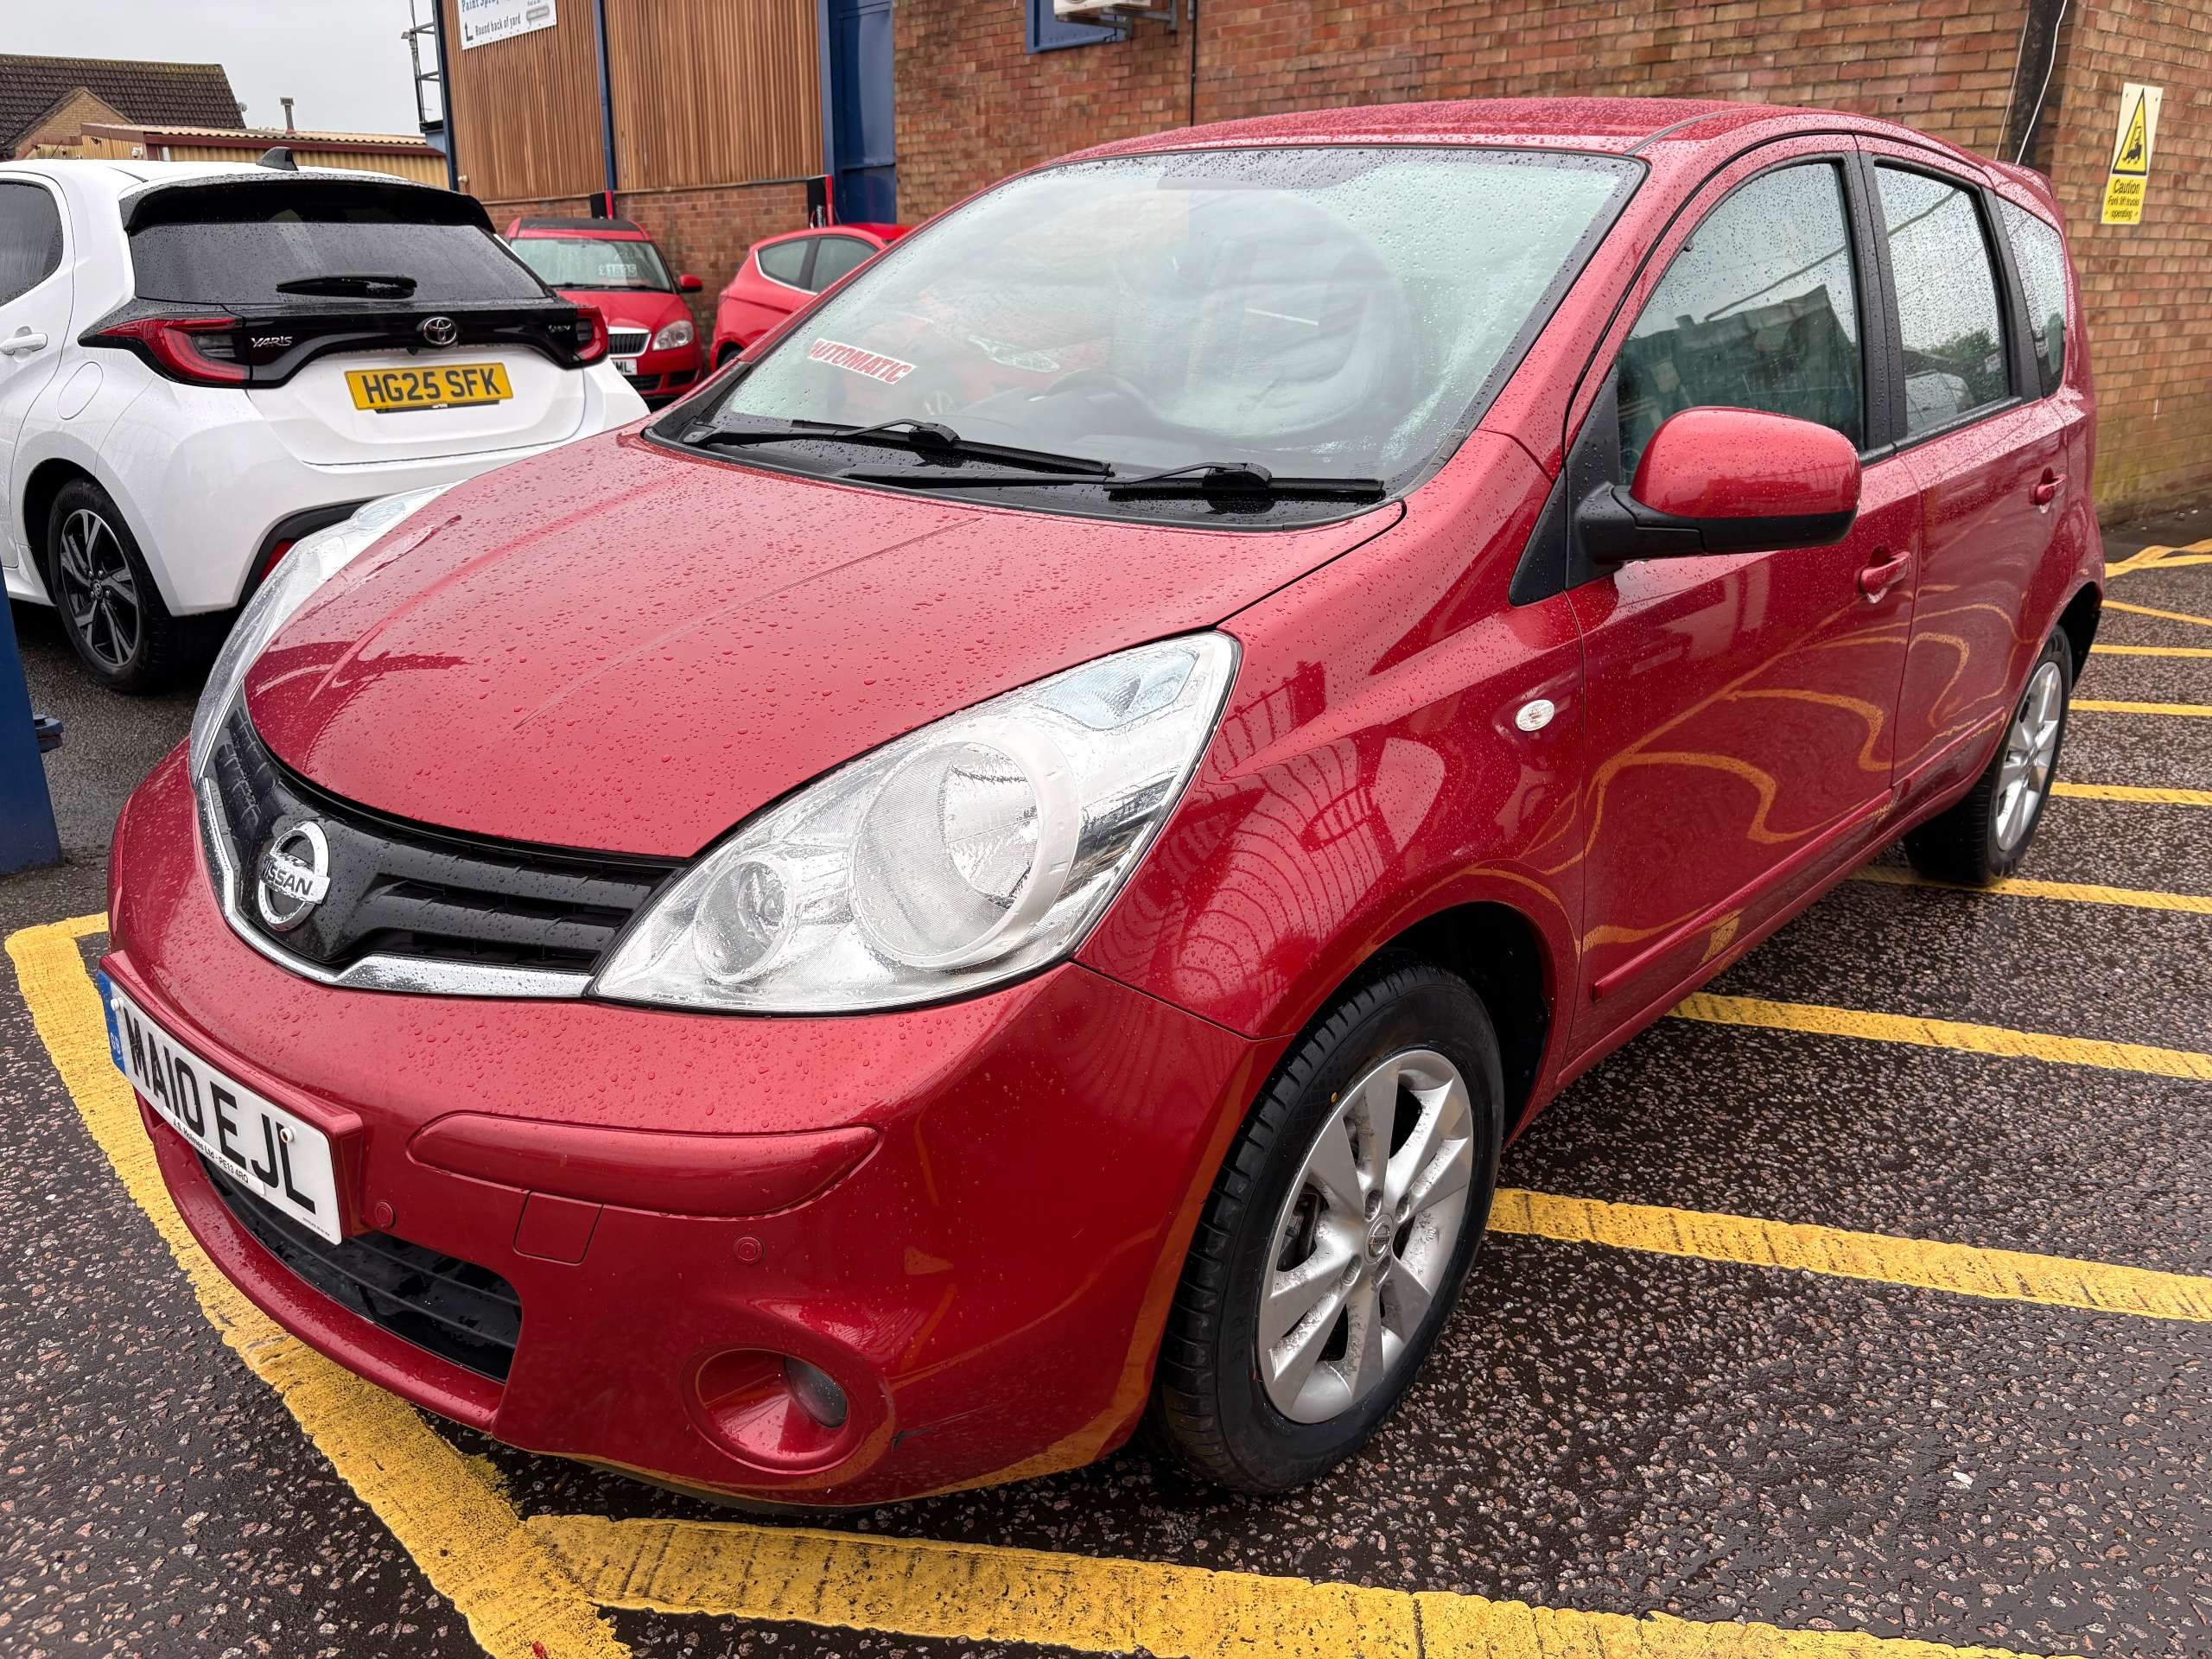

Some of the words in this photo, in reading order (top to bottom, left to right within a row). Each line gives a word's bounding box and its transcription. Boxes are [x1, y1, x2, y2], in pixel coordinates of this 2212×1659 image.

[2113, 179, 2140, 194] Caution
[2108, 195, 2119, 206] Fork
[2111, 209, 2133, 219] operating
[251, 336, 292, 347] YARIS
[613, 360, 632, 372] ML
[810, 340, 912, 383] AUTOMATIC
[361, 370, 440, 404] HG25
[445, 367, 502, 397] SFK
[110, 1032, 121, 1055] GB
[124, 1007, 205, 1138] MA10
[210, 1080, 317, 1215] EJL
[183, 1127, 204, 1151] Holmes
[204, 1145, 214, 1159] Ltd
